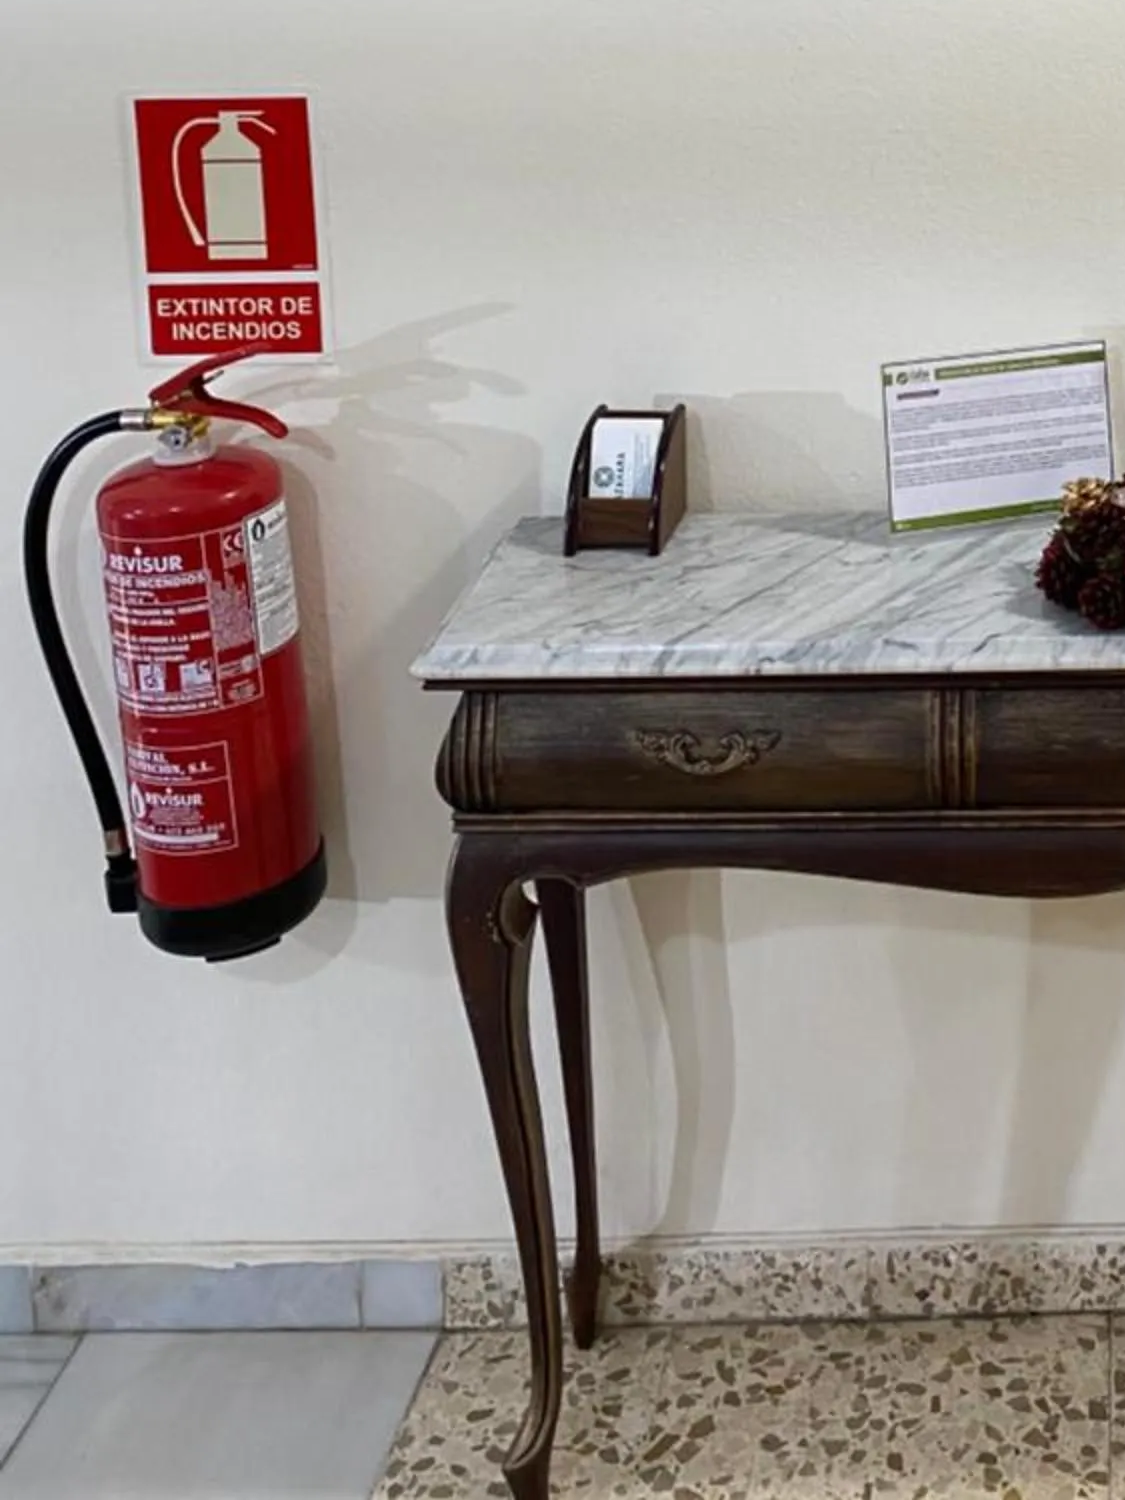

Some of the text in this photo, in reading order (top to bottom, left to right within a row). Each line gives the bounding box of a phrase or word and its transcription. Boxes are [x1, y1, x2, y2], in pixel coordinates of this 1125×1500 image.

[156, 296, 313, 317] EXTINTOR DE
[172, 321, 302, 341] INCENDIOS
